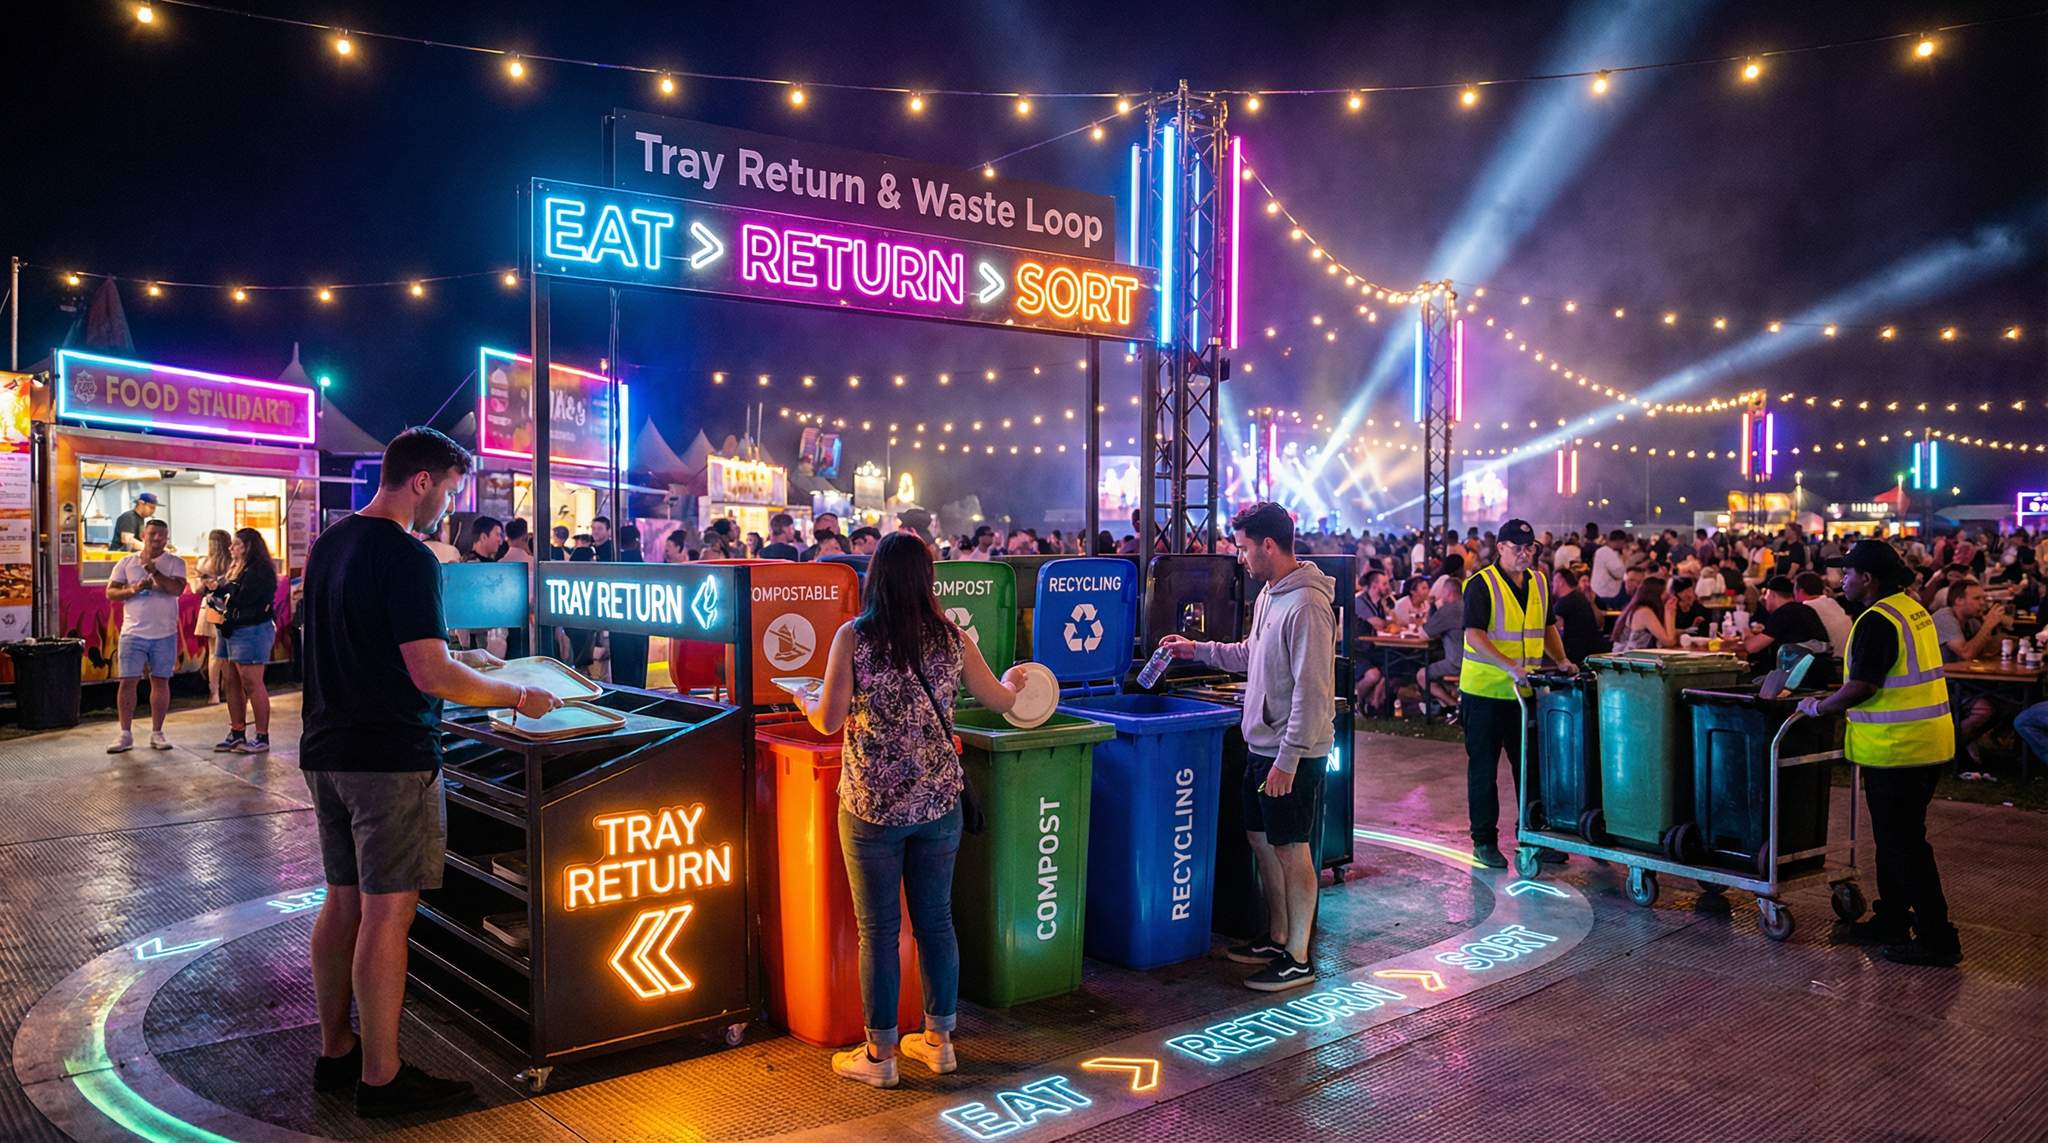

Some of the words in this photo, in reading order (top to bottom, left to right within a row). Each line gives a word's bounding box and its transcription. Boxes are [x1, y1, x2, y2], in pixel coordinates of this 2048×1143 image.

[635, 131, 724, 189] Tray
[739, 147, 865, 205] Return
[877, 172, 901, 210] &
[912, 177, 1016, 226] Waste
[1025, 197, 1103, 248] Loop
[544, 196, 674, 270] EAT
[740, 223, 965, 306] RETURN
[1015, 262, 1140, 325] SORT
[106, 375, 179, 412] FOOD
[545, 578, 597, 616] TRAY
[599, 581, 683, 625] RETURN
[751, 585, 839, 602] OMPOSTABLE
[932, 580, 994, 597] OMPOST
[1049, 576, 1122, 593] RECYCLING
[597, 806, 704, 856] TRAY
[1171, 767, 1194, 922] RECYCLING
[567, 845, 731, 908] RETURN
[1036, 797, 1061, 942] COMPOST
[941, 1075, 1093, 1140] EAT
[1166, 981, 1406, 1063] RETURN
[1435, 924, 1559, 972] SORT
